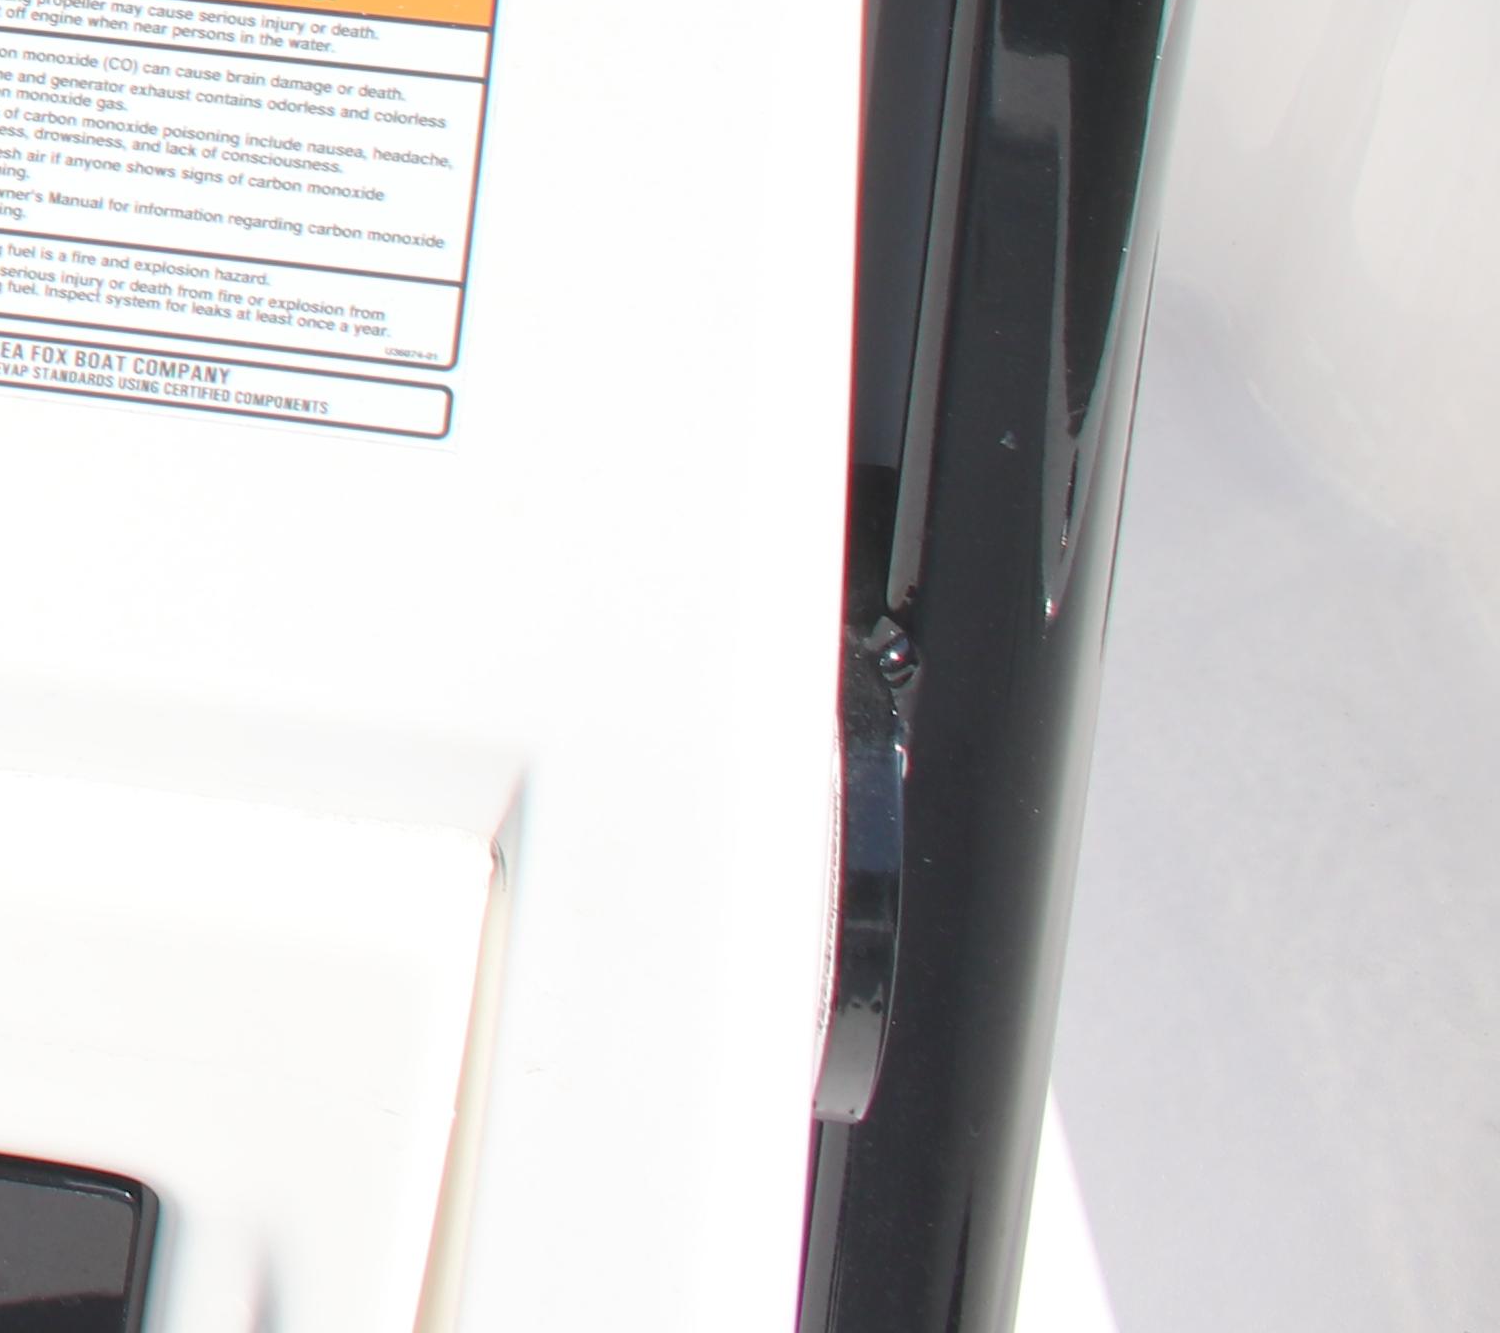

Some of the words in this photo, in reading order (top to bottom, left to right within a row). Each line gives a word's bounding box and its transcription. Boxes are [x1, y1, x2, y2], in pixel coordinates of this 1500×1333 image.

[5, 5, 31, 20] off
[30, 11, 84, 26] engine
[87, 16, 130, 31] when
[133, 22, 168, 36] near
[172, 26, 236, 43] persons
[240, 31, 255, 44] in
[259, 33, 285, 48] the
[288, 38, 335, 53] water.
[110, 2, 144, 18] may
[147, 6, 196, 21] cause
[198, 11, 257, 28] serious
[261, 16, 307, 35] injury
[310, 23, 328, 35] or
[330, 23, 379, 40] death.
[22, 50, 100, 69] monoxide
[103, 57, 139, 75] (CO)
[142, 64, 171, 76] can
[175, 67, 223, 82] cause
[226, 69, 267, 86] brain
[270, 75, 334, 95] damage
[337, 84, 354, 96] or
[358, 85, 406, 101] death.
[7, 243, 37, 259] fuel
[40, 247, 55, 261] is
[58, 252, 68, 263] a
[71, 250, 97, 266] fire
[100, 256, 131, 270] and
[133, 260, 211, 279] explosion
[214, 267, 270, 286] hazard.
[31, 345, 68, 365] FOX
[74, 350, 128, 372] BOAT
[133, 356, 231, 384] COMPANY
[33, 366, 115, 388] STANDARDS
[118, 377, 160, 394] USING
[163, 382, 231, 403] CERTIFIED
[234, 391, 329, 415] COMPONENTS
